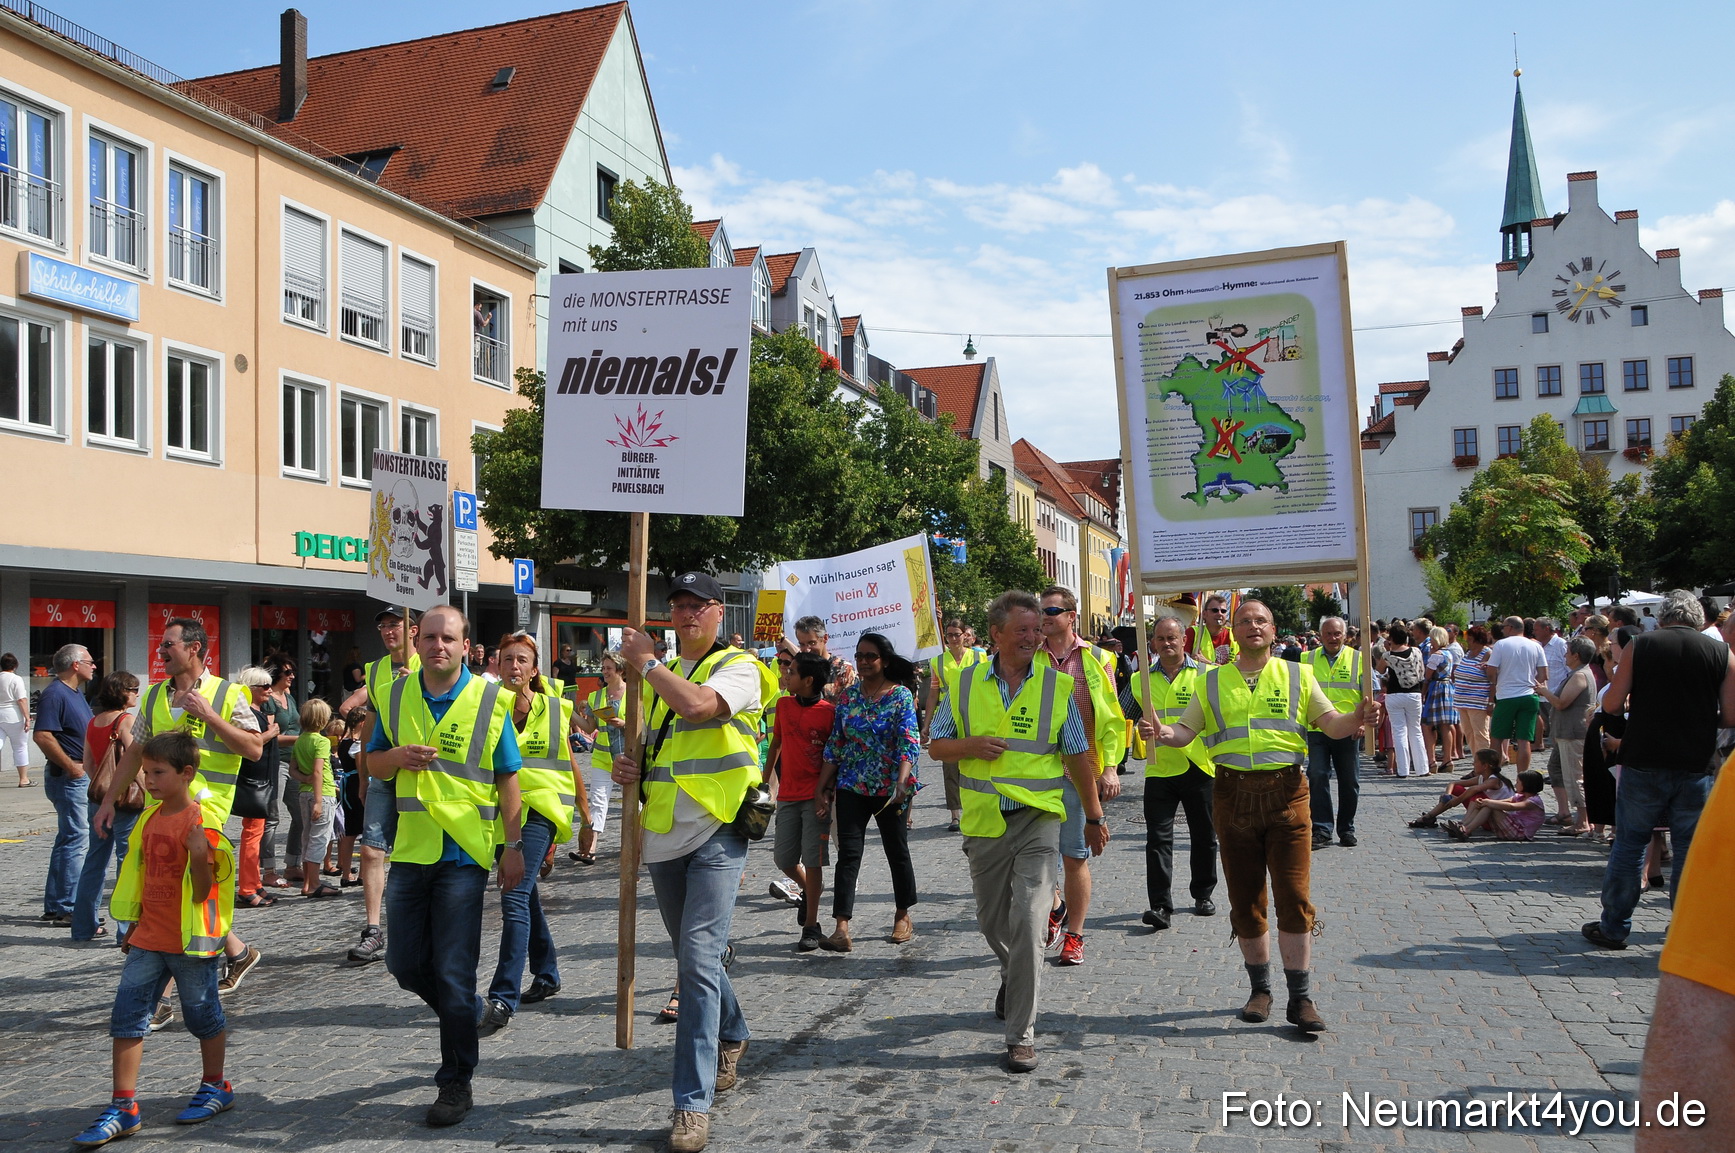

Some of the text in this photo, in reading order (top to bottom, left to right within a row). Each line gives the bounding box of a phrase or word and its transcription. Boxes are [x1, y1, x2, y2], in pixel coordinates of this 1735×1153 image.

[563, 288, 732, 308] die MONSTERTRASSE
[1134, 291, 1160, 300] 21.853
[562, 317, 618, 332] mit uns
[556, 348, 738, 396] niemals!
[621, 450, 658, 464] BÜRGER-
[372, 452, 446, 482] MONSTERTRASSE
[617, 467, 660, 479] INITIATIVE
[612, 482, 664, 494] PAVELSBACH
[460, 496, 472, 524] P
[389, 560, 422, 576] Ein Geschenk
[808, 559, 896, 586] Mühlhausen sagt
[400, 574, 409, 583] Für
[519, 564, 529, 590] P
[396, 584, 414, 596] Bayern
[835, 589, 863, 602] Nein
[831, 600, 902, 625] Stromtrasse
[842, 629, 858, 638] Aus-
[872, 622, 896, 633] Neubau
[442, 746, 456, 754] WAHN
